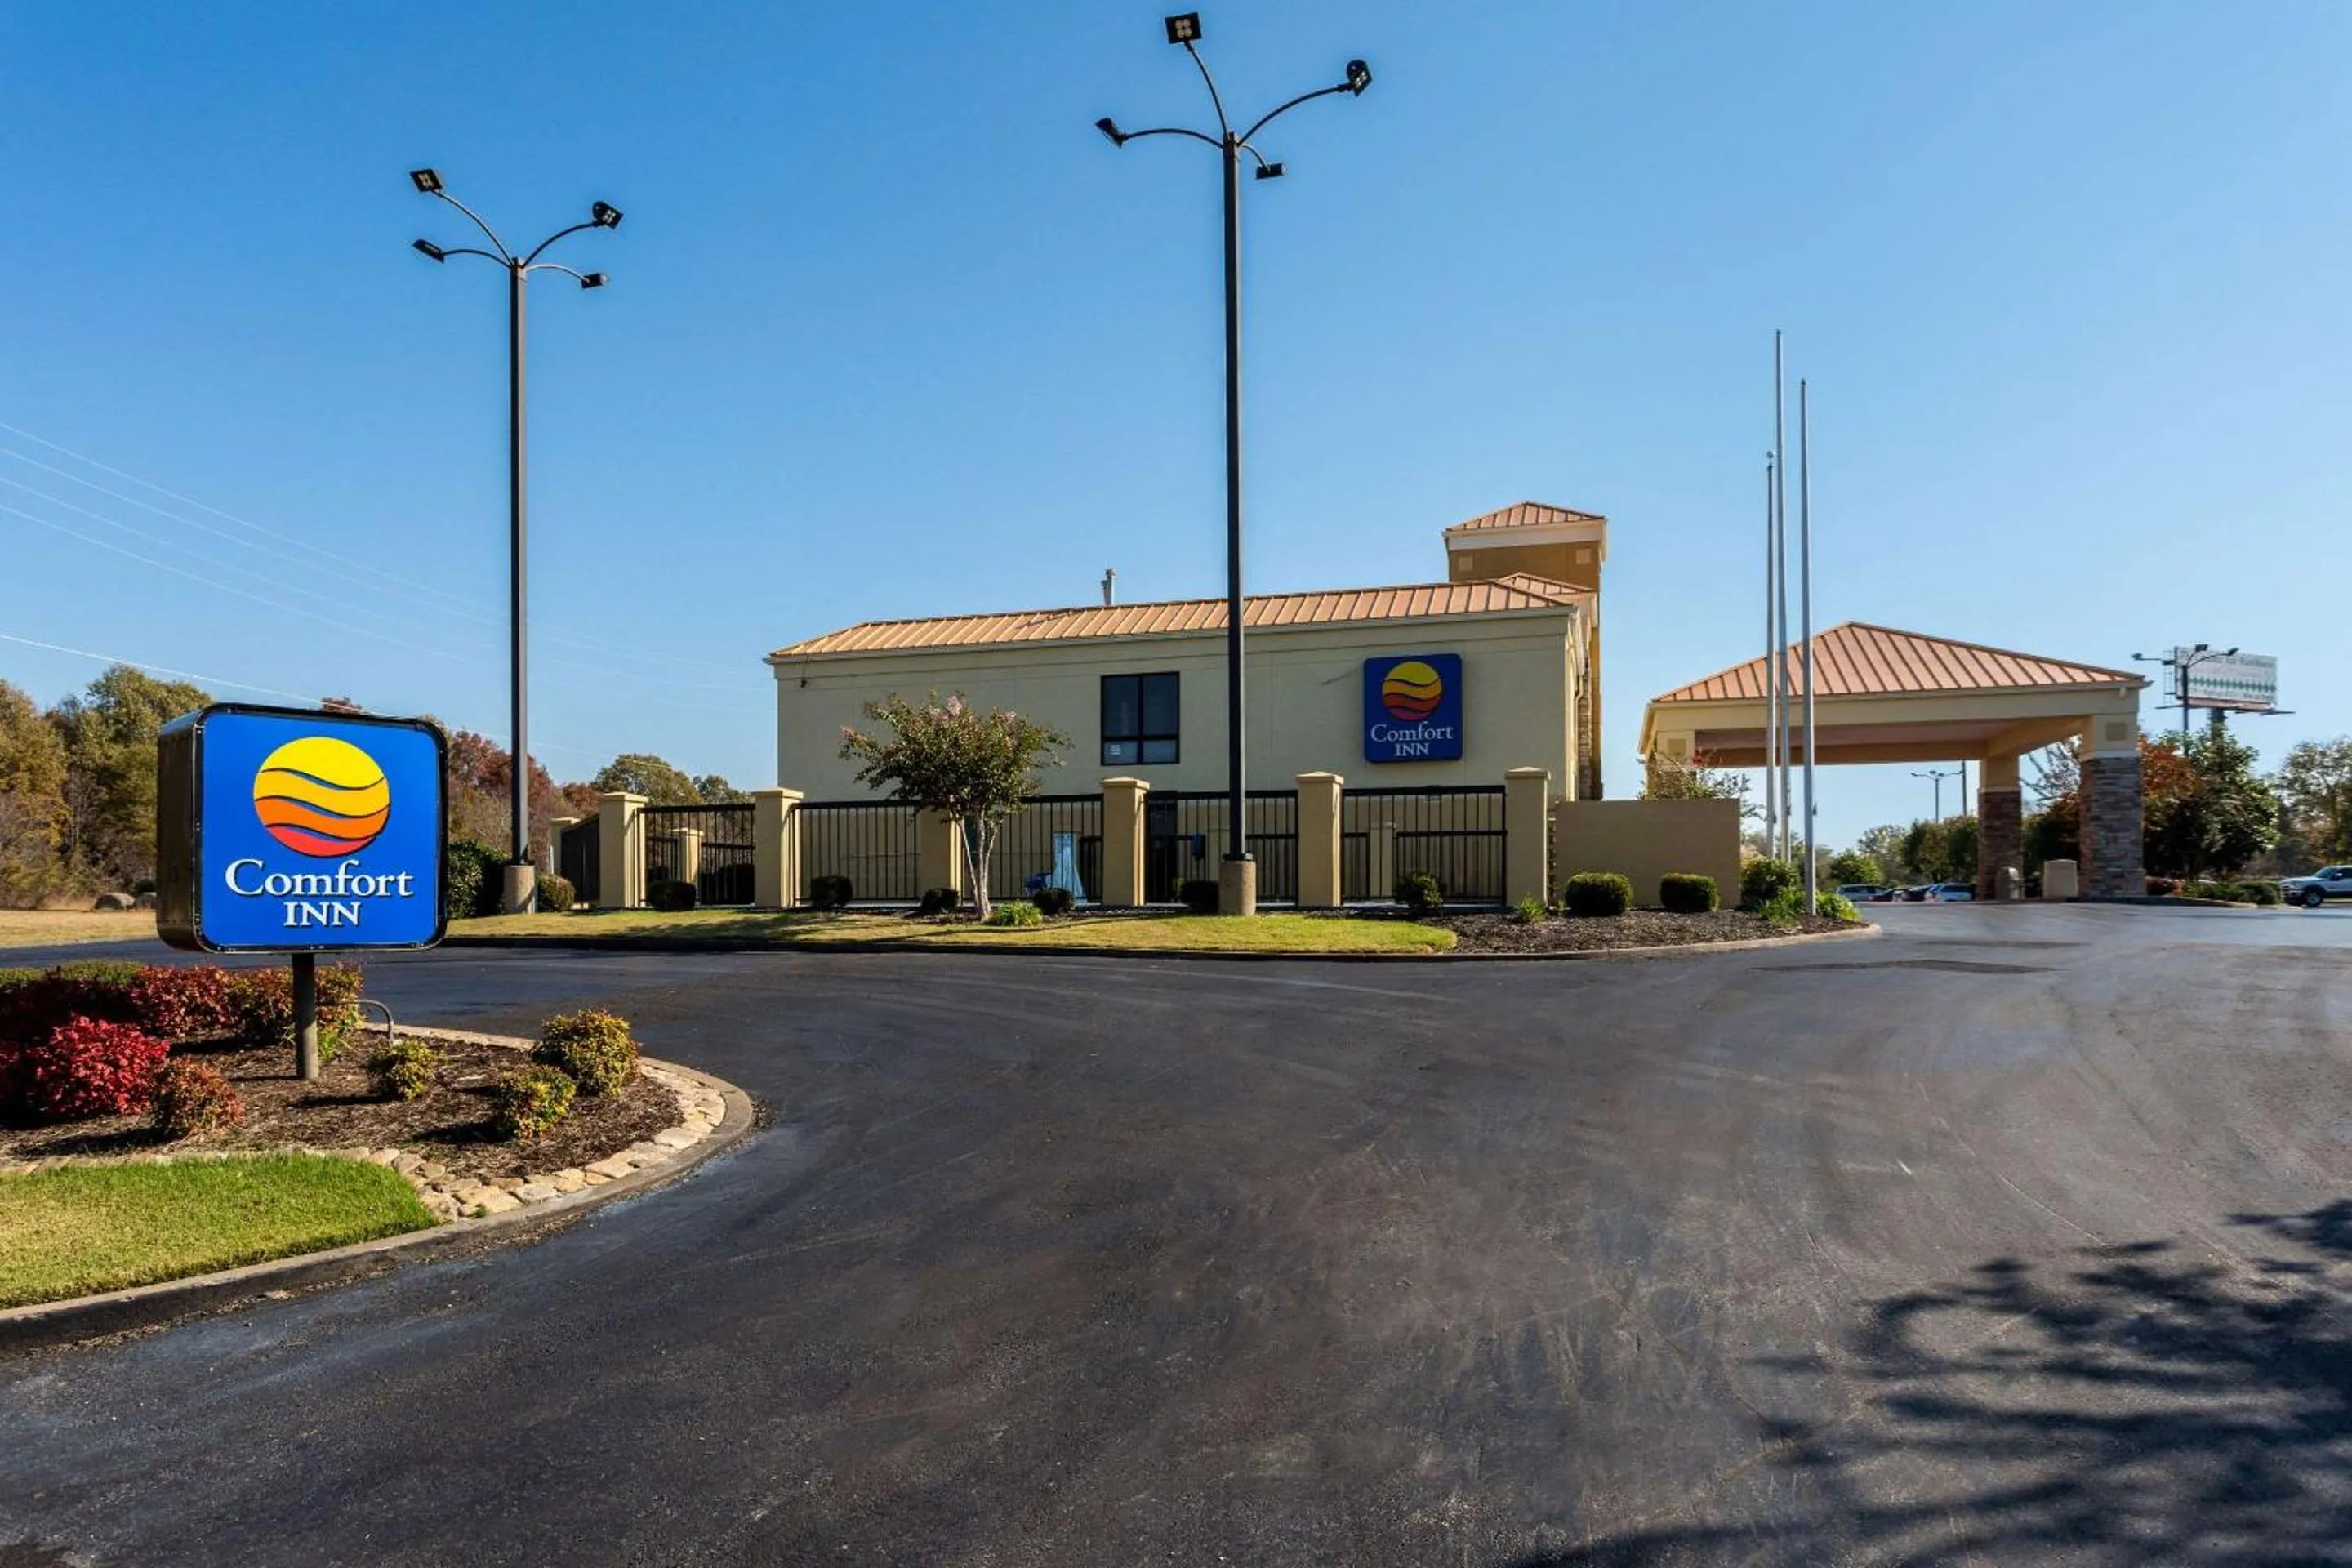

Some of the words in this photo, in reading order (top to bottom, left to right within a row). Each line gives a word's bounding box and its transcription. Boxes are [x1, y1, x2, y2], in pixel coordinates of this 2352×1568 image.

[1370, 721, 1454, 742] Comfort
[1394, 742, 1428, 756] INN
[225, 859, 414, 897] Comfort
[283, 901, 361, 927] INN
